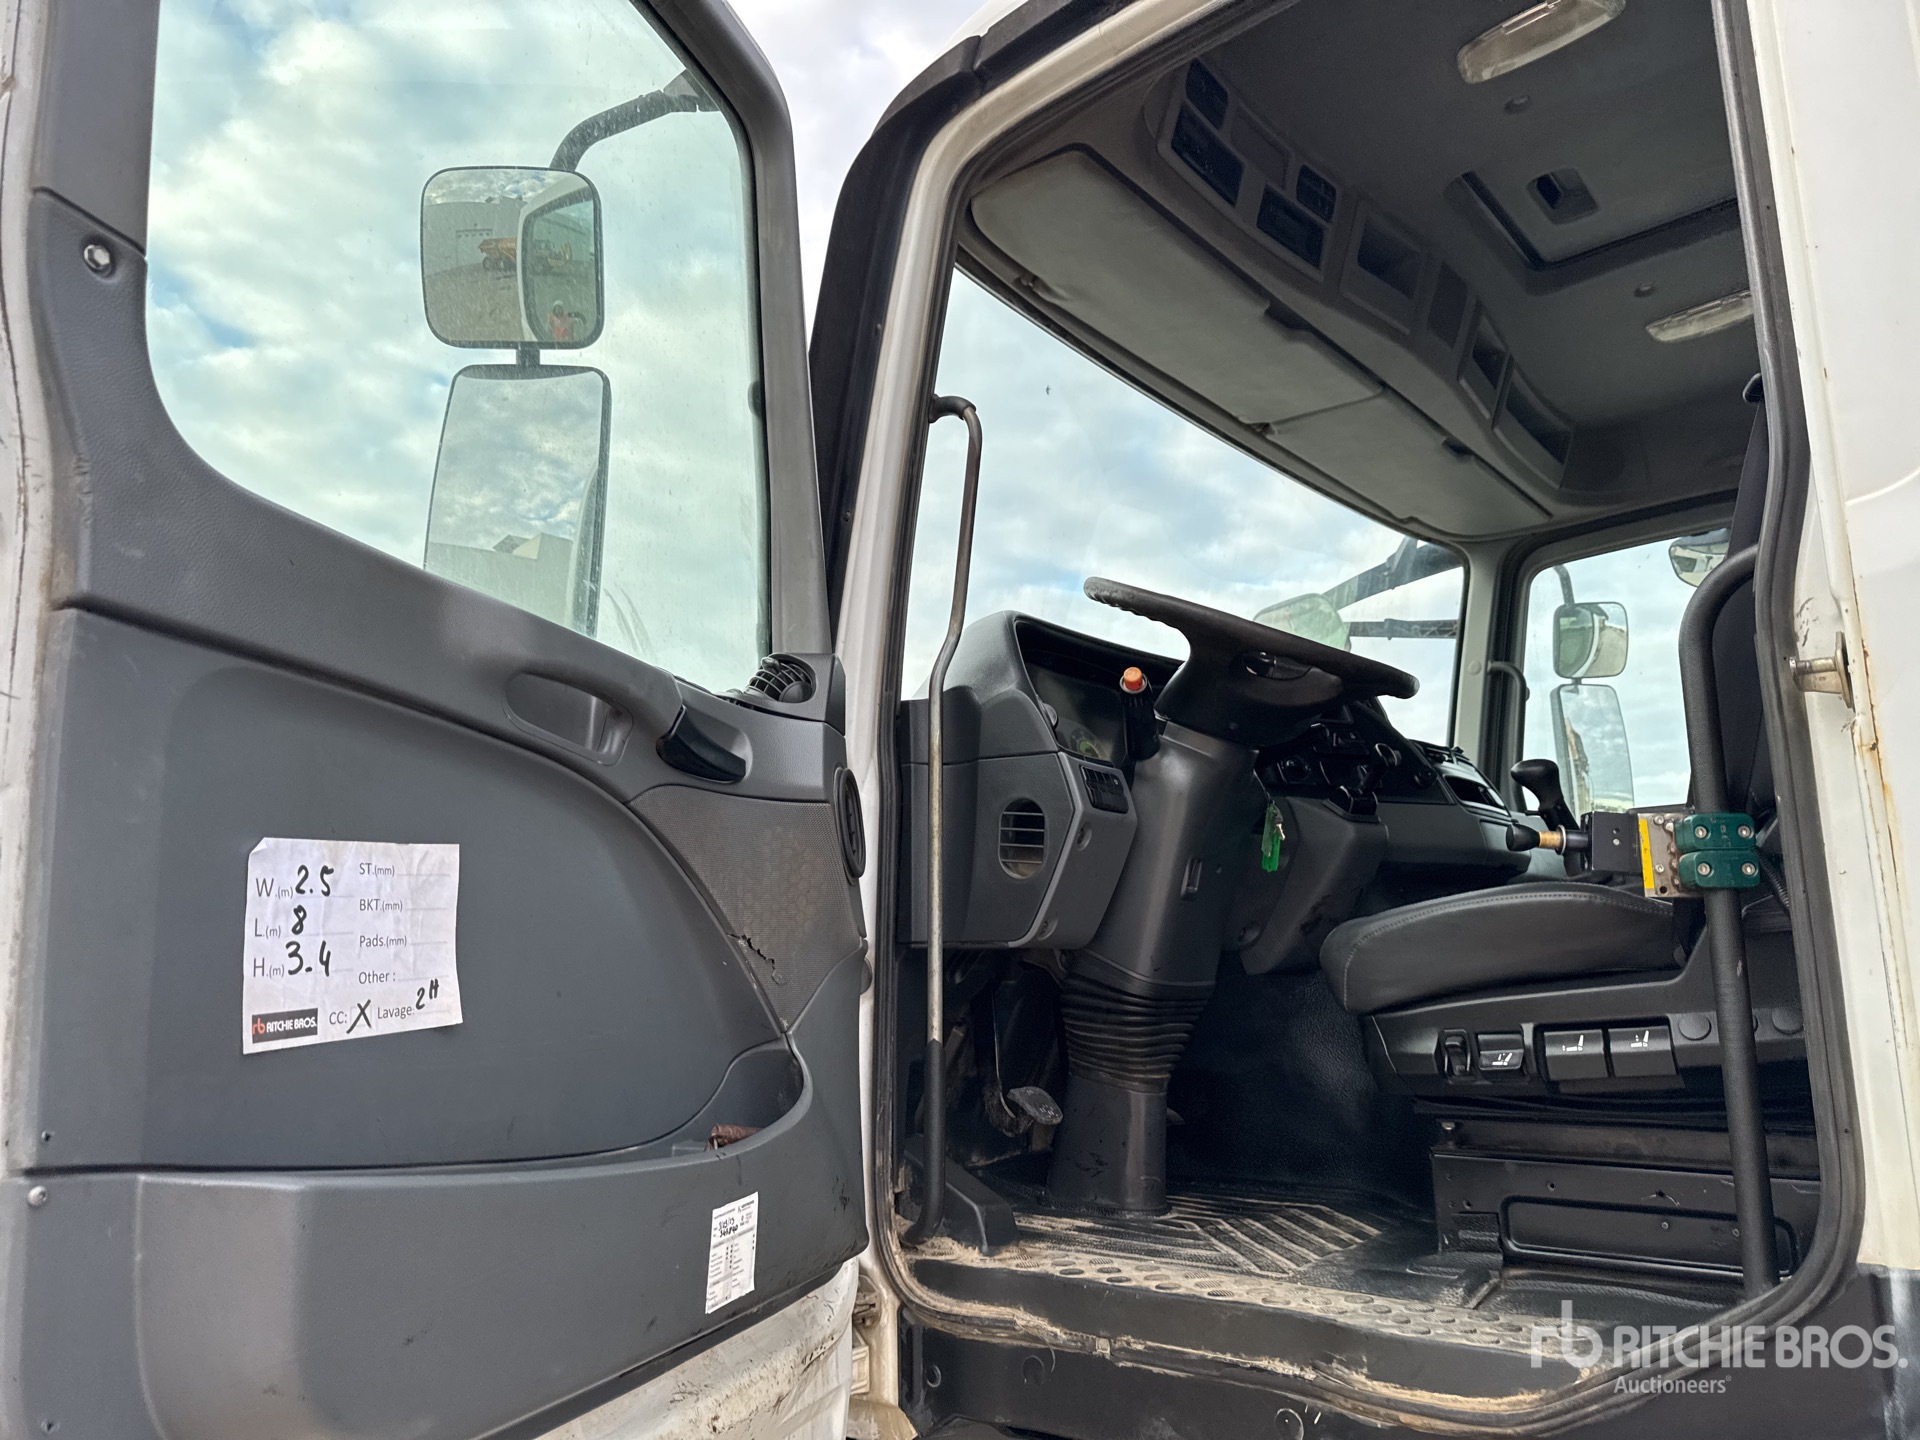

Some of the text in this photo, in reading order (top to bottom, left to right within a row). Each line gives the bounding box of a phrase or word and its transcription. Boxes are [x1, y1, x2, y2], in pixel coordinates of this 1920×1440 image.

[255, 864, 334, 899] W.(m) 2.5
[291, 904, 307, 935] 8
[285, 940, 331, 977] 3.4
[266, 1019, 294, 1033] RITCHIE
[294, 1016, 317, 1030] BROS.
[329, 1010, 347, 1025] CC:
